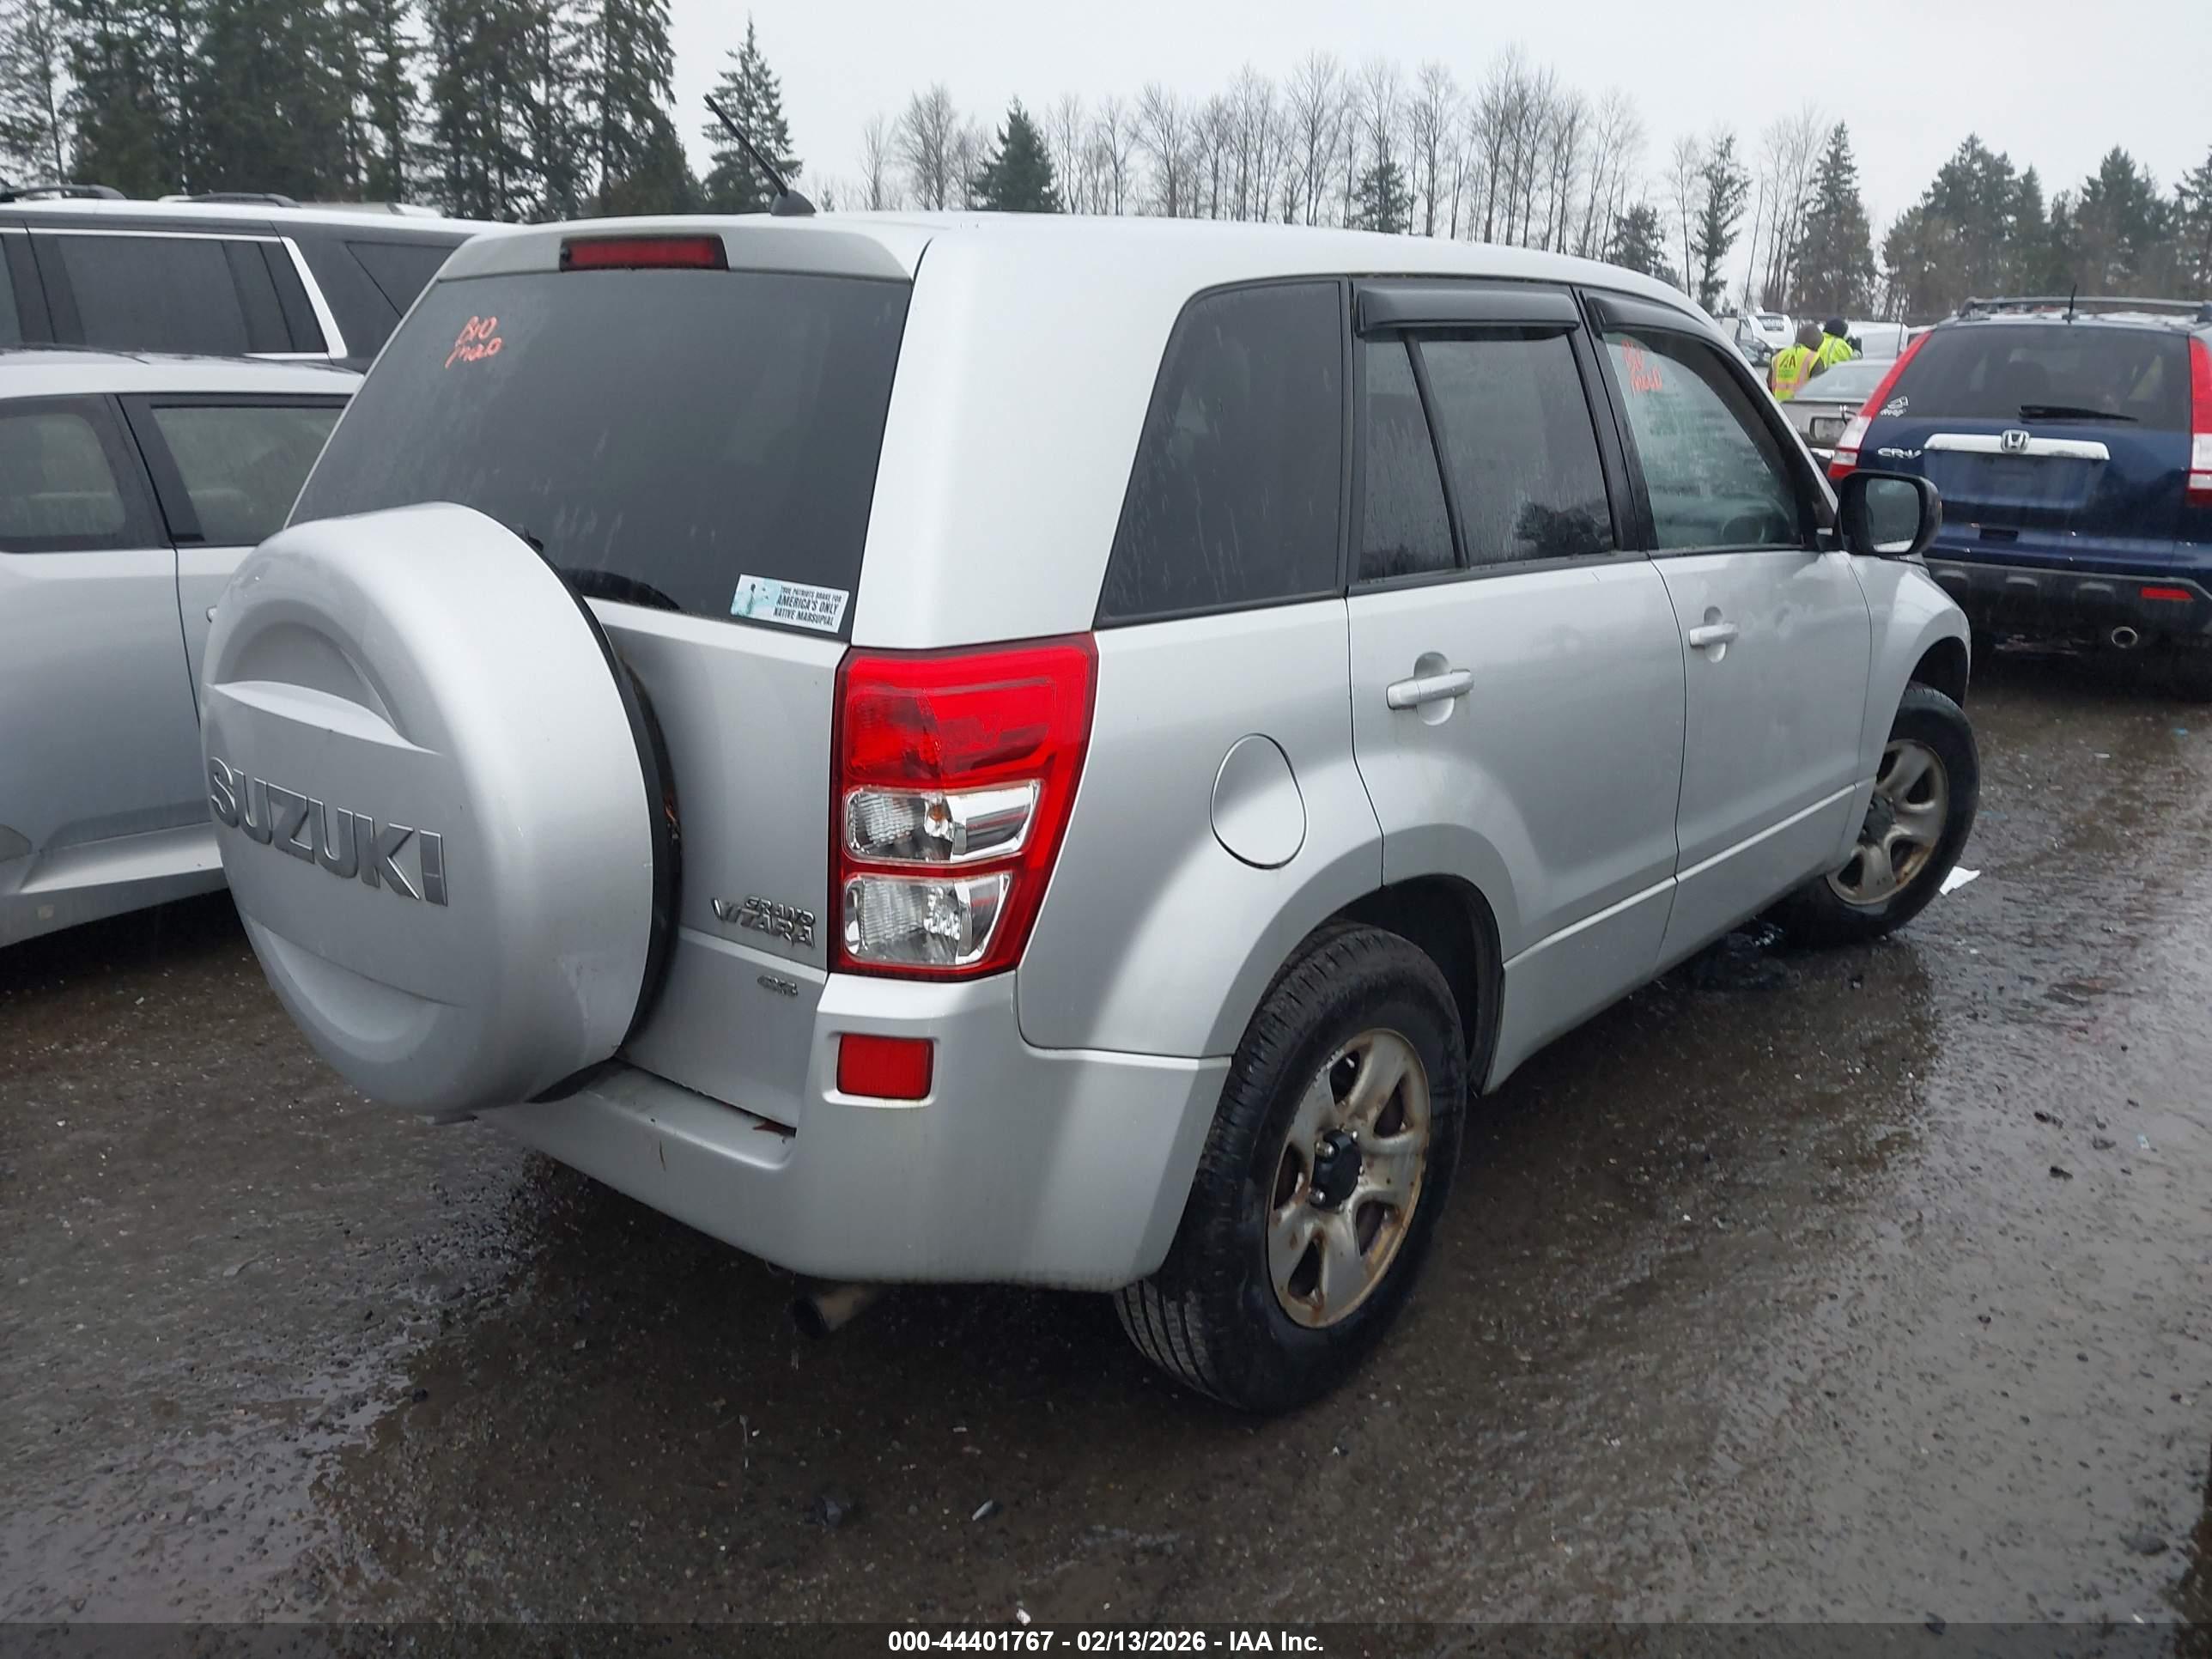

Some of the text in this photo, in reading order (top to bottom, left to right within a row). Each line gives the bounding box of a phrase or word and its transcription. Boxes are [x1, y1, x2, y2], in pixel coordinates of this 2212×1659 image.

[774, 607, 834, 626] NATIVE MARSUPIAL
[776, 594, 839, 615] AMERICA'S ONLY
[210, 756, 449, 907] SUZUKI
[710, 897, 816, 949] VITARA
[744, 894, 816, 927] GRAND
